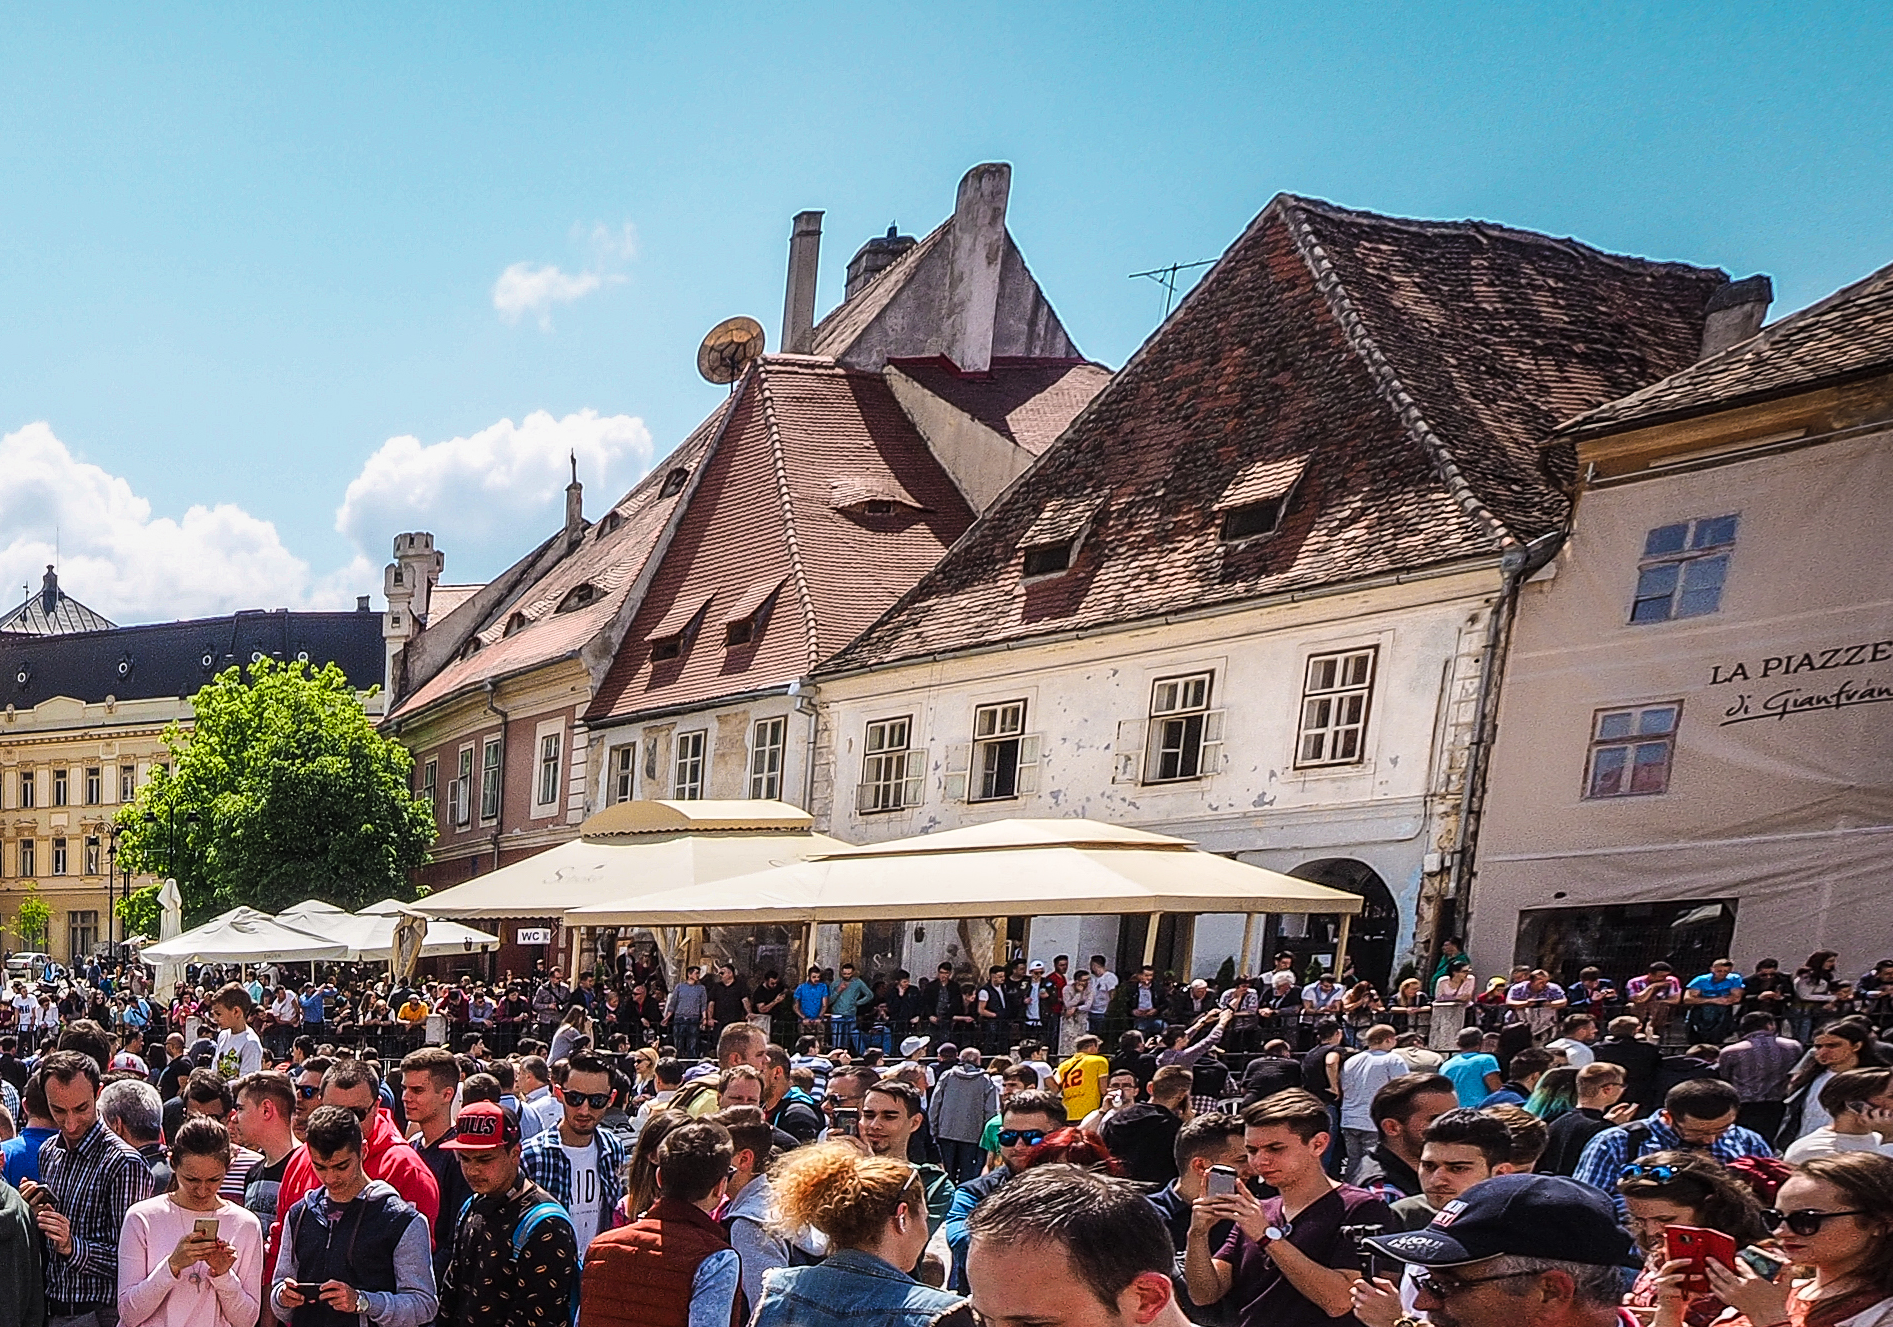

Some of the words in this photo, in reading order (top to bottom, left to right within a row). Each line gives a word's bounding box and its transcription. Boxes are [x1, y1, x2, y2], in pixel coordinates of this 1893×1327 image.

[1709, 662, 1751, 686] LA
[1759, 640, 1893, 679] PIAZZE
[1725, 694, 1752, 717] di
[521, 931, 540, 941] WC
